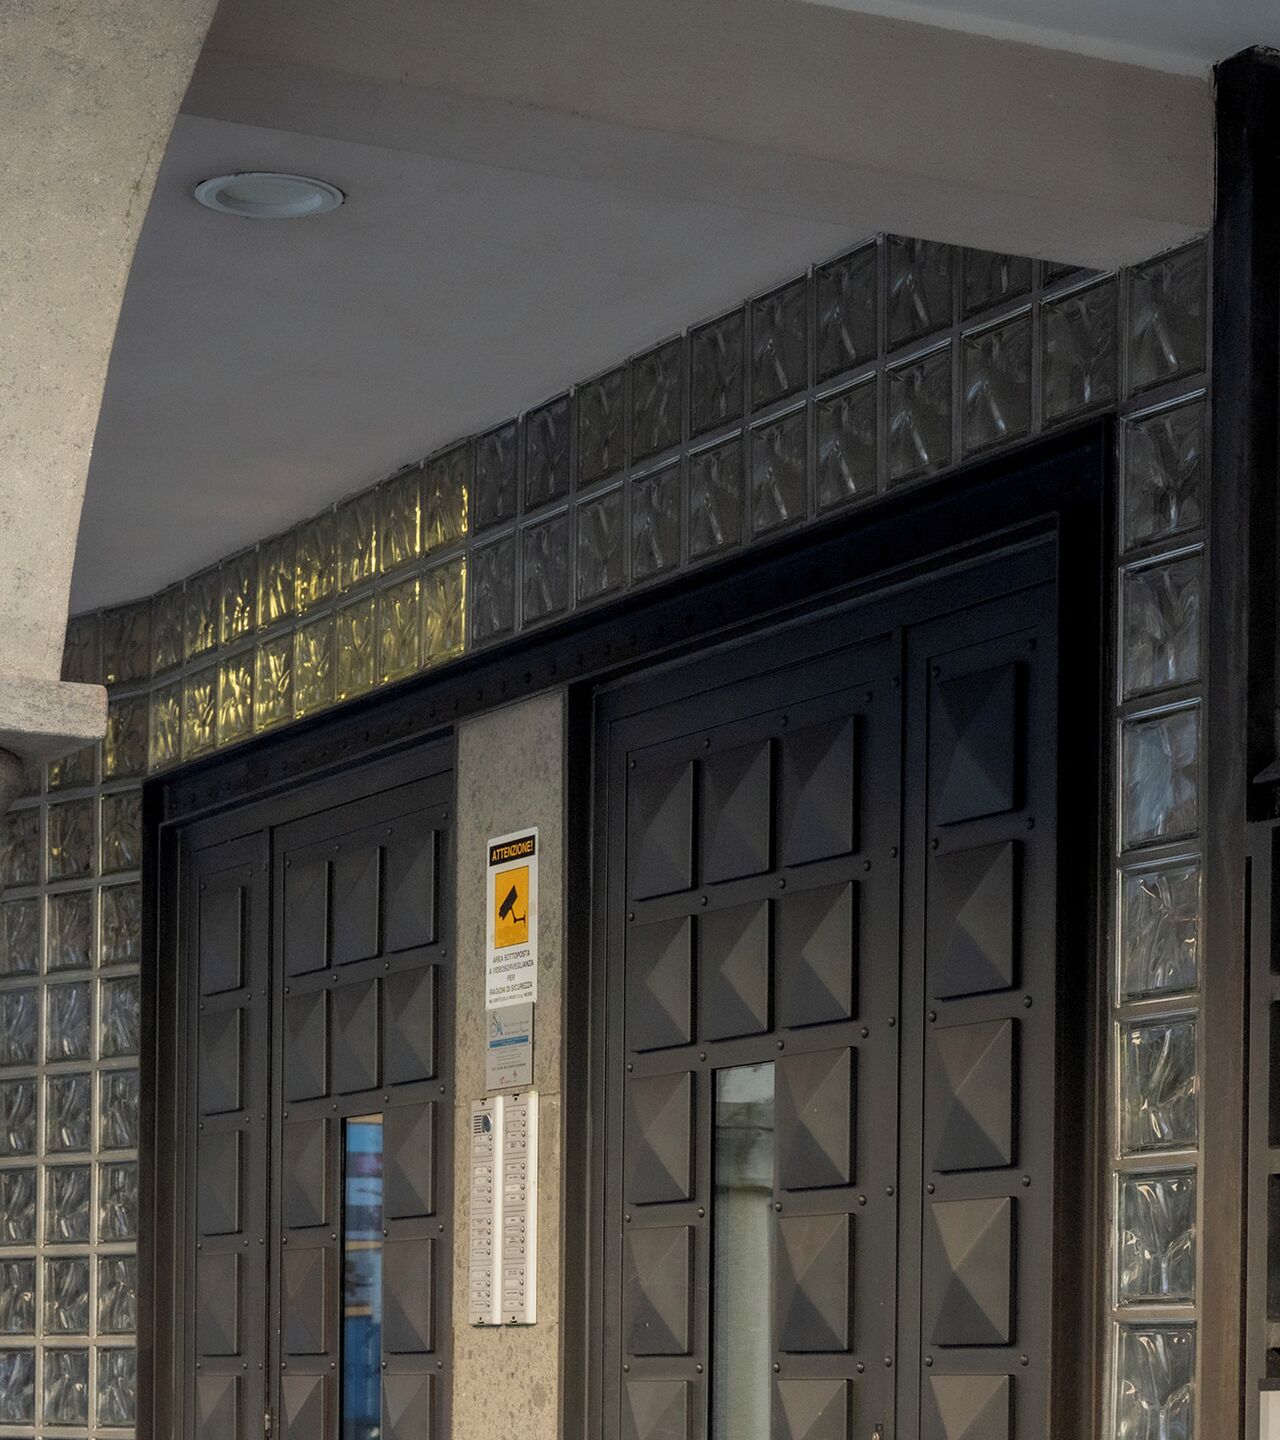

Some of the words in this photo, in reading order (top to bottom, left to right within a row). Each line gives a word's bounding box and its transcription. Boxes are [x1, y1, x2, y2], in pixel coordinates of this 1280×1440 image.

[492, 840, 533, 861] ATTENZIONE!
[493, 955, 503, 963] AREA
[504, 950, 530, 961] SOTTOPOSTA
[493, 960, 533, 974] VIDEOSORVEGLIANZA
[489, 986, 505, 995] RAGIONI
[511, 982, 532, 992] SICUREZZA
